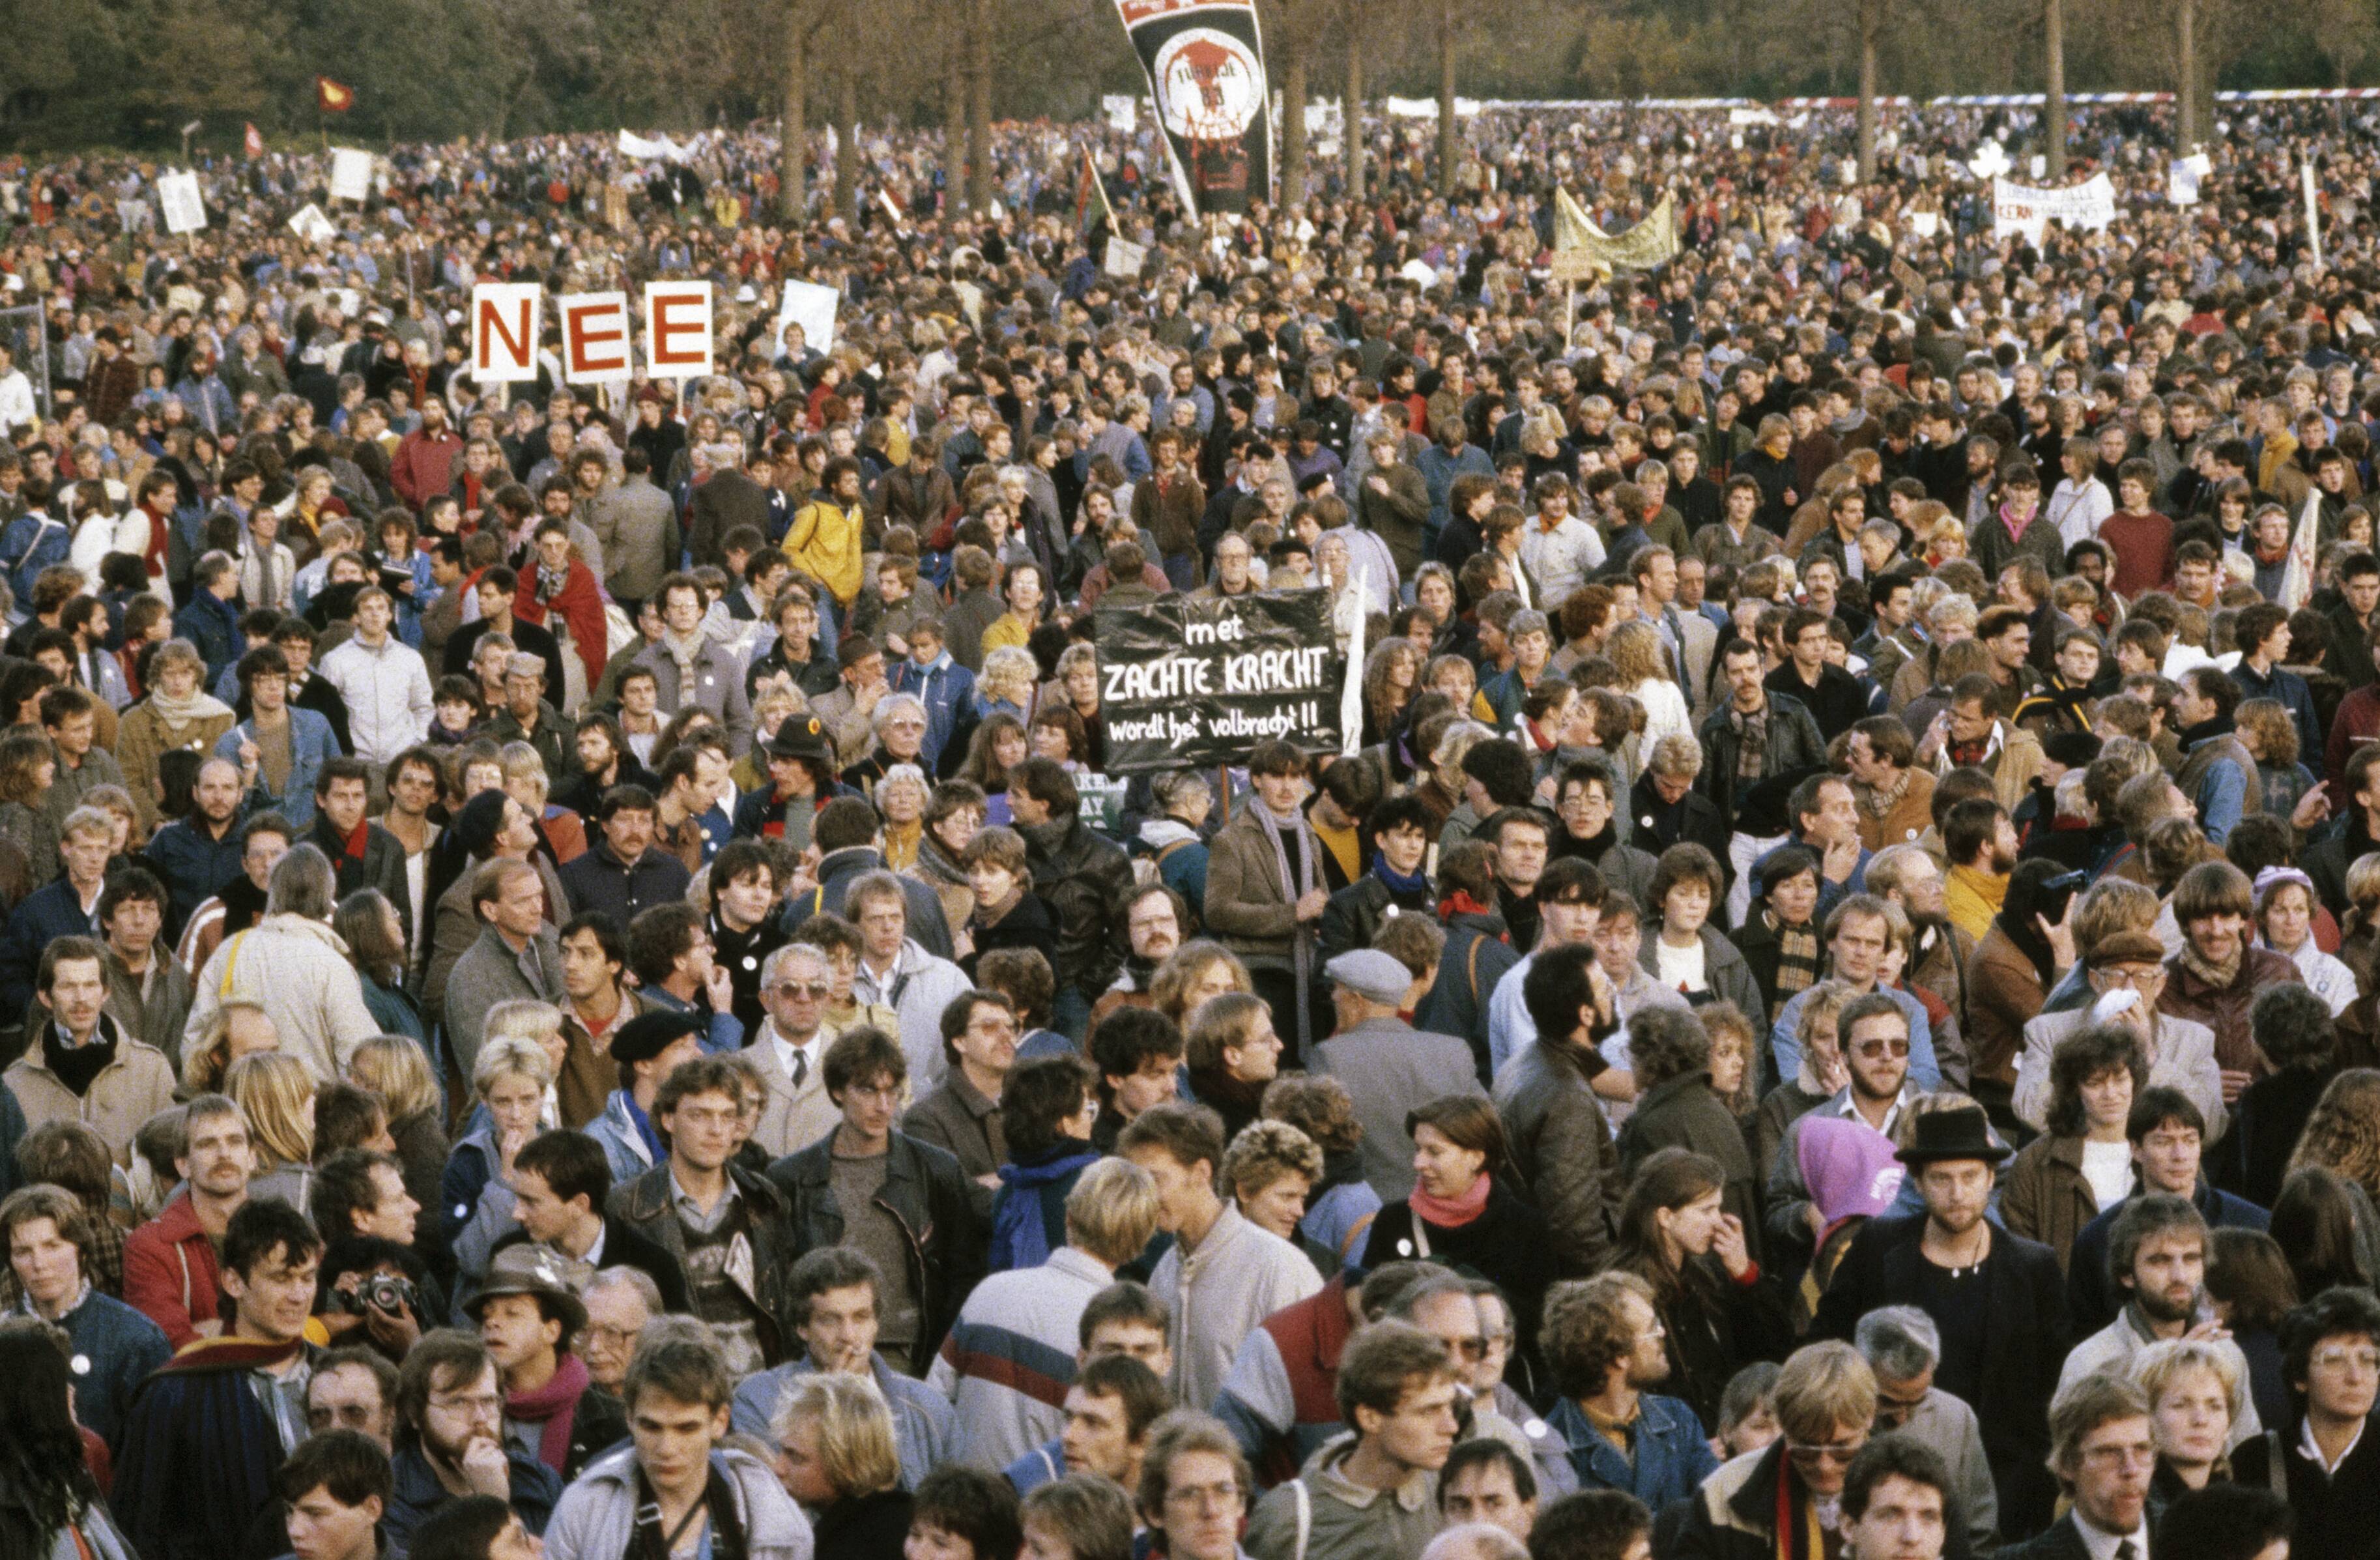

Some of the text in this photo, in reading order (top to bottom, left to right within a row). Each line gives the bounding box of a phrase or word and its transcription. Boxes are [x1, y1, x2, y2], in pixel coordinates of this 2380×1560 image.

[1184, 614, 1244, 645] met
[1102, 646, 1330, 701] ZACHTE KRACHT
[1108, 711, 1167, 742] wordt
[1169, 710, 1200, 749] het
